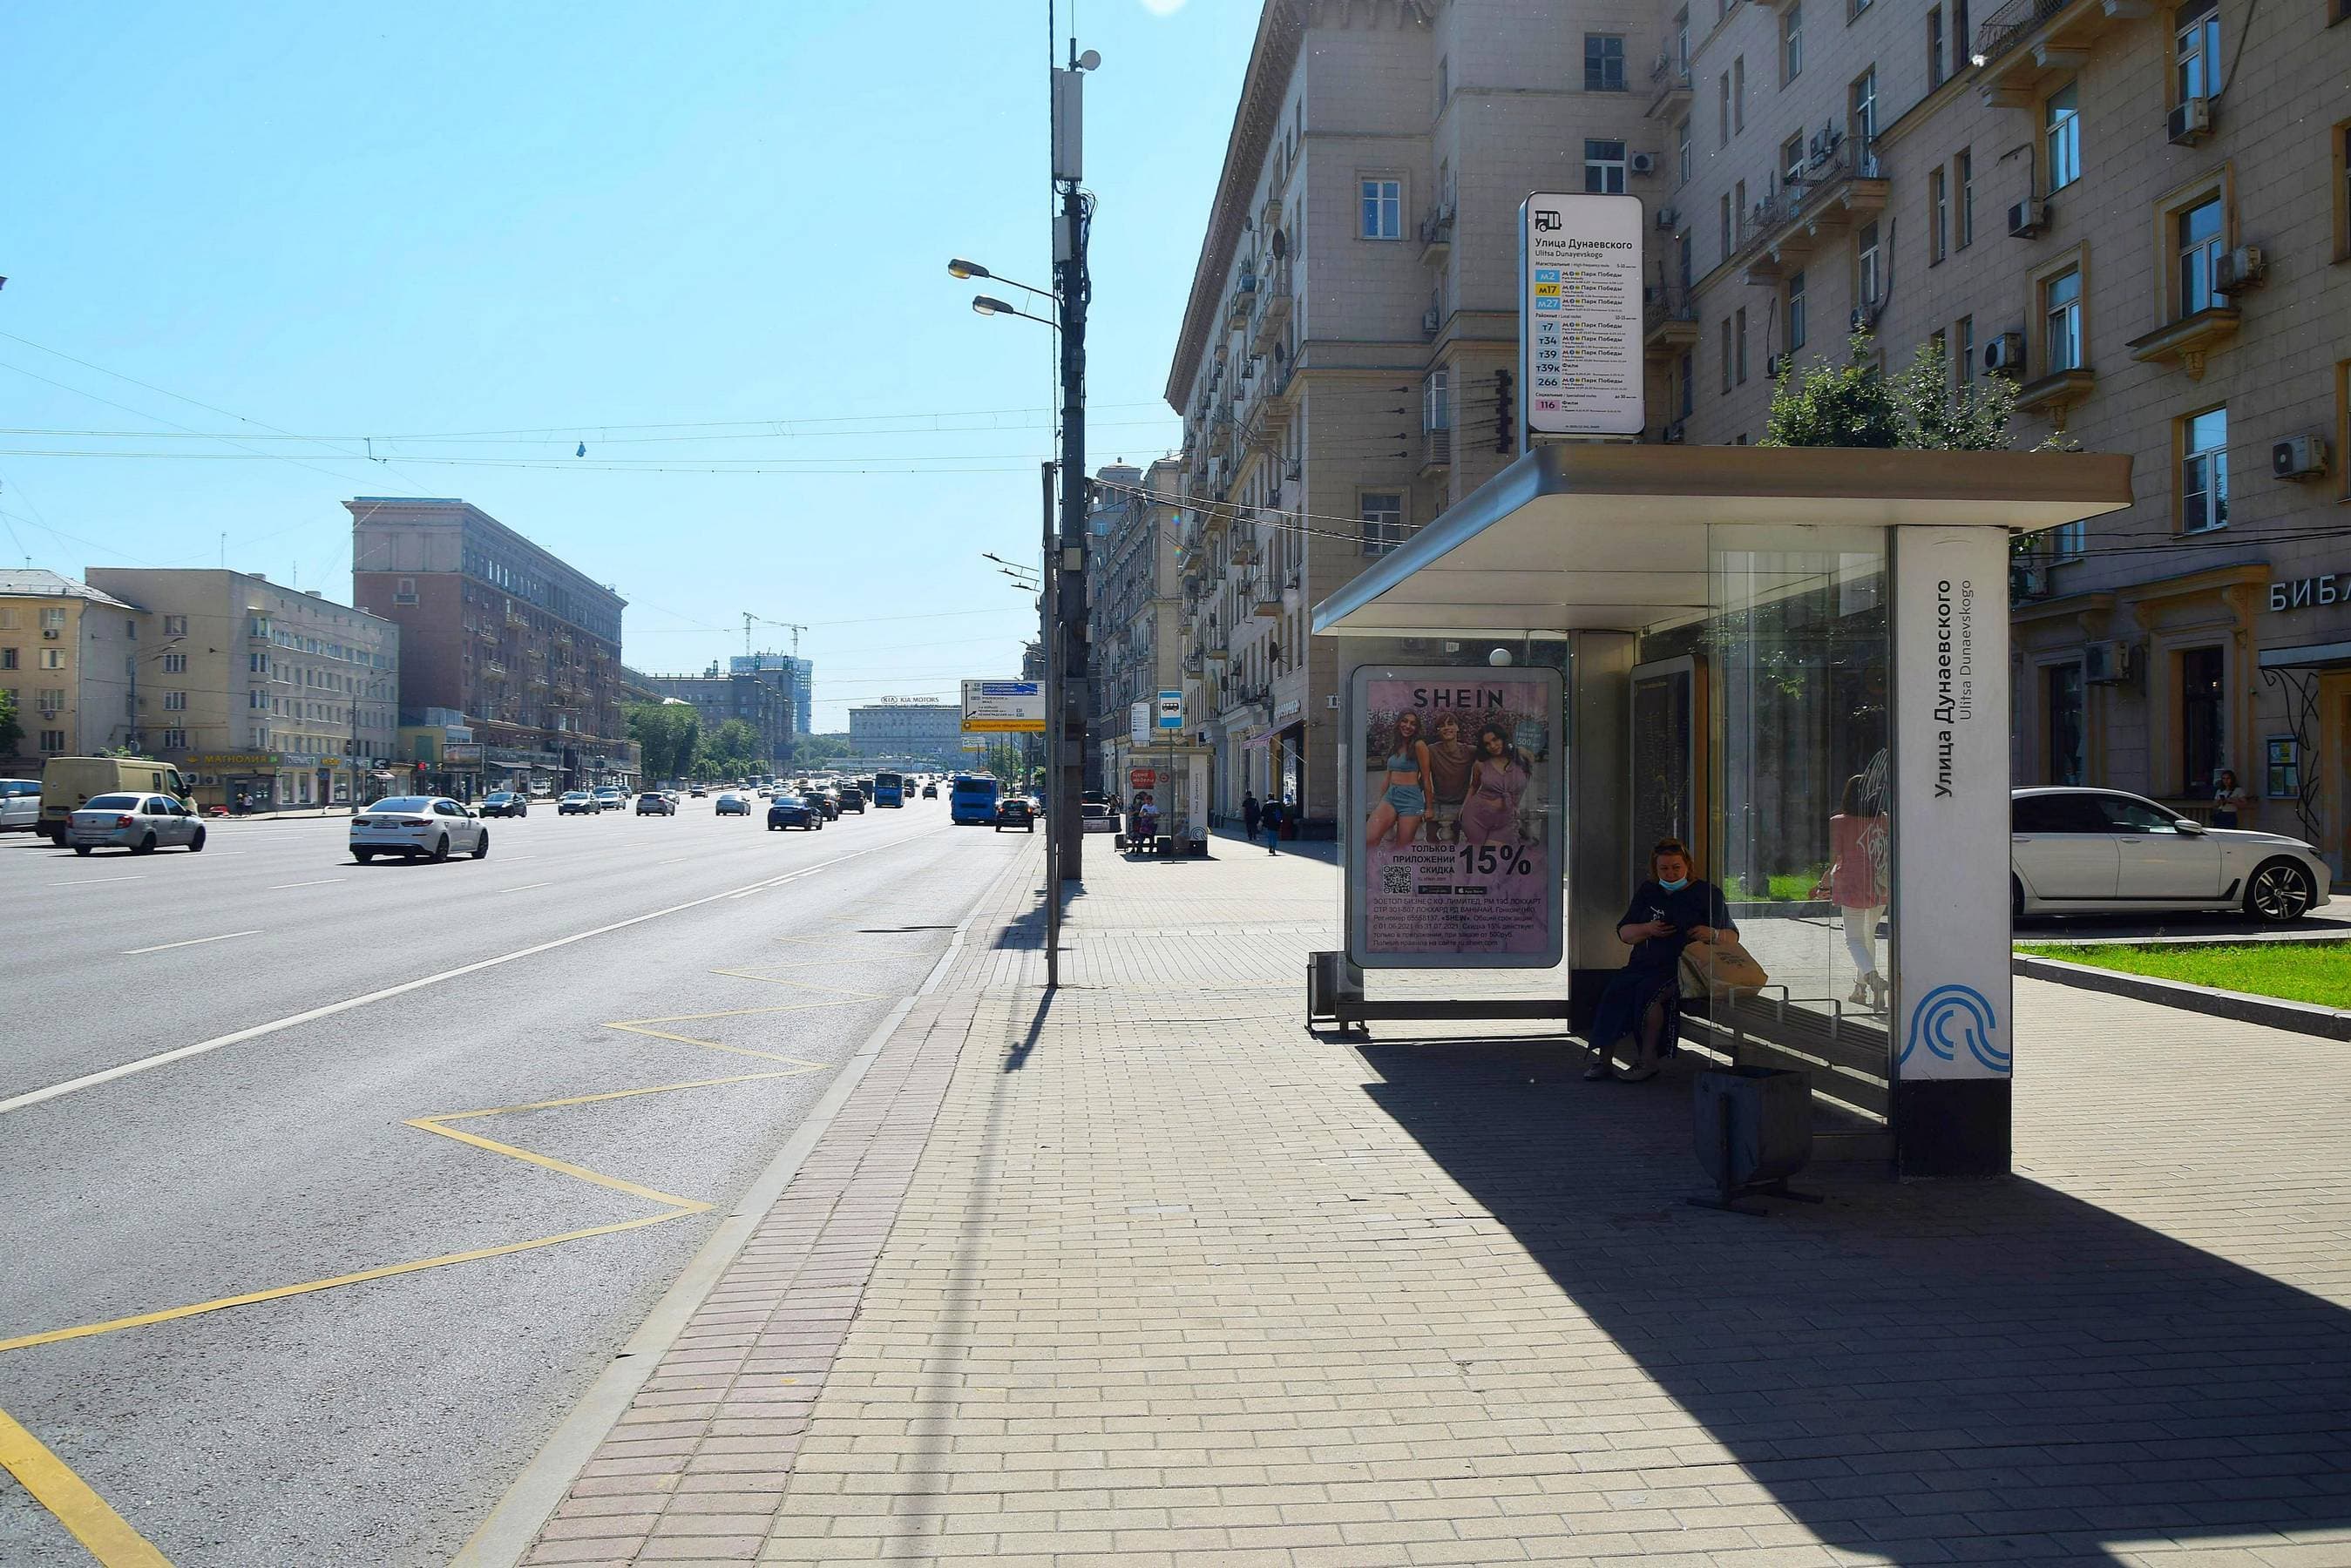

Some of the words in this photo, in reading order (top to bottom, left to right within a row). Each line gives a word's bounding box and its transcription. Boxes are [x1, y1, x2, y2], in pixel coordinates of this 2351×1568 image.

[1535, 238, 1566, 248] Улица
[1568, 239, 1633, 250] Дунаевского
[1555, 250, 1603, 259] Dunayevskogo
[1541, 272, 1555, 280] м2
[1539, 336, 1557, 345] т34
[1535, 364, 1560, 373] т39к
[1958, 579, 1974, 676] Dunaevskogo
[1934, 579, 1955, 724] Дунаевского
[1413, 688, 1504, 708] SHEIN
[1960, 680, 1972, 720] Ulitsa
[205, 755, 267, 764] МАГНОЛИЯ
[1934, 730, 1953, 798] Улица
[1412, 845, 1447, 854] ТОЛЬКО
[1392, 855, 1455, 864] ПРИЛОЖЕНИИ
[1460, 845, 1532, 875] 15%
[1419, 866, 1455, 875] СКИДКА
